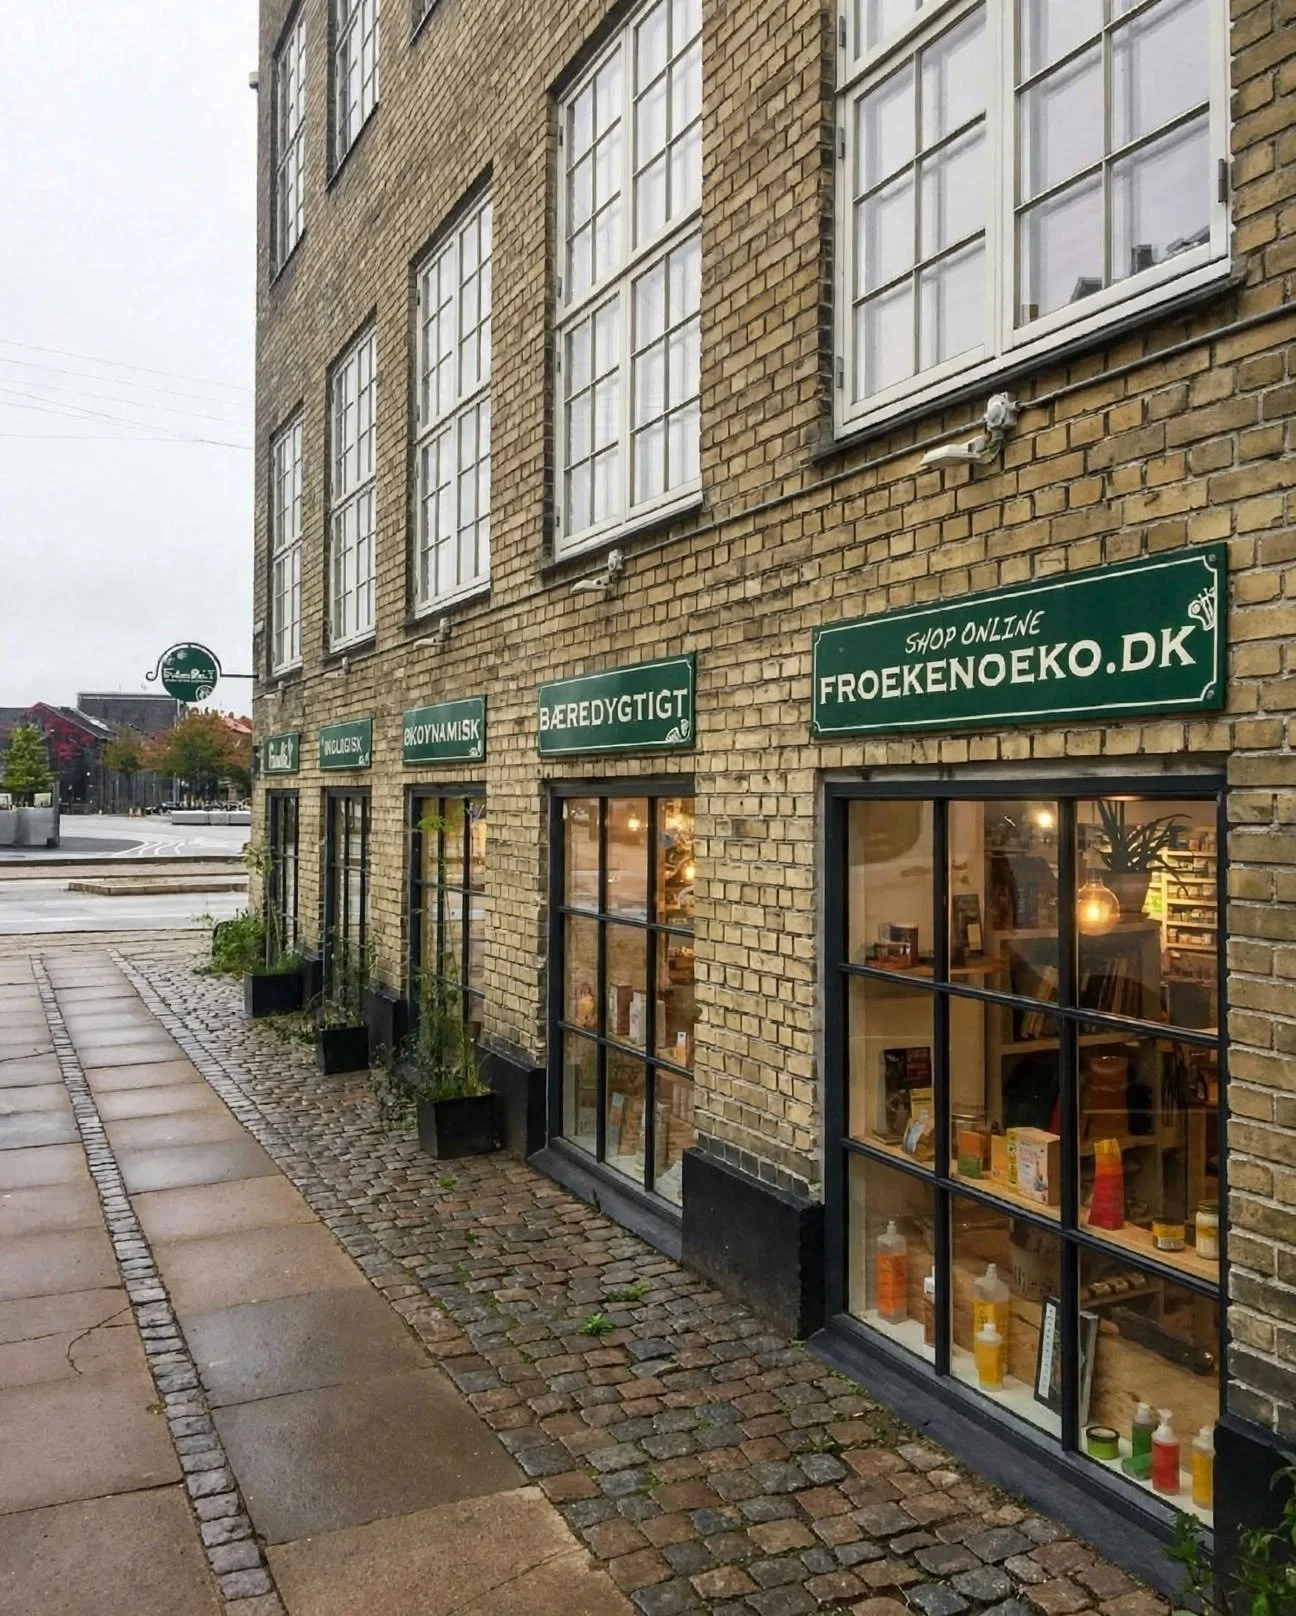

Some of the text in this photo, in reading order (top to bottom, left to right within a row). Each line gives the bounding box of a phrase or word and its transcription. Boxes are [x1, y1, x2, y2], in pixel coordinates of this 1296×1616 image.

[905, 609, 1045, 655] SHOP ONLINE
[819, 624, 1197, 705] FROEKENOEKO.DK
[540, 688, 688, 731] BÆREDYGTIGT
